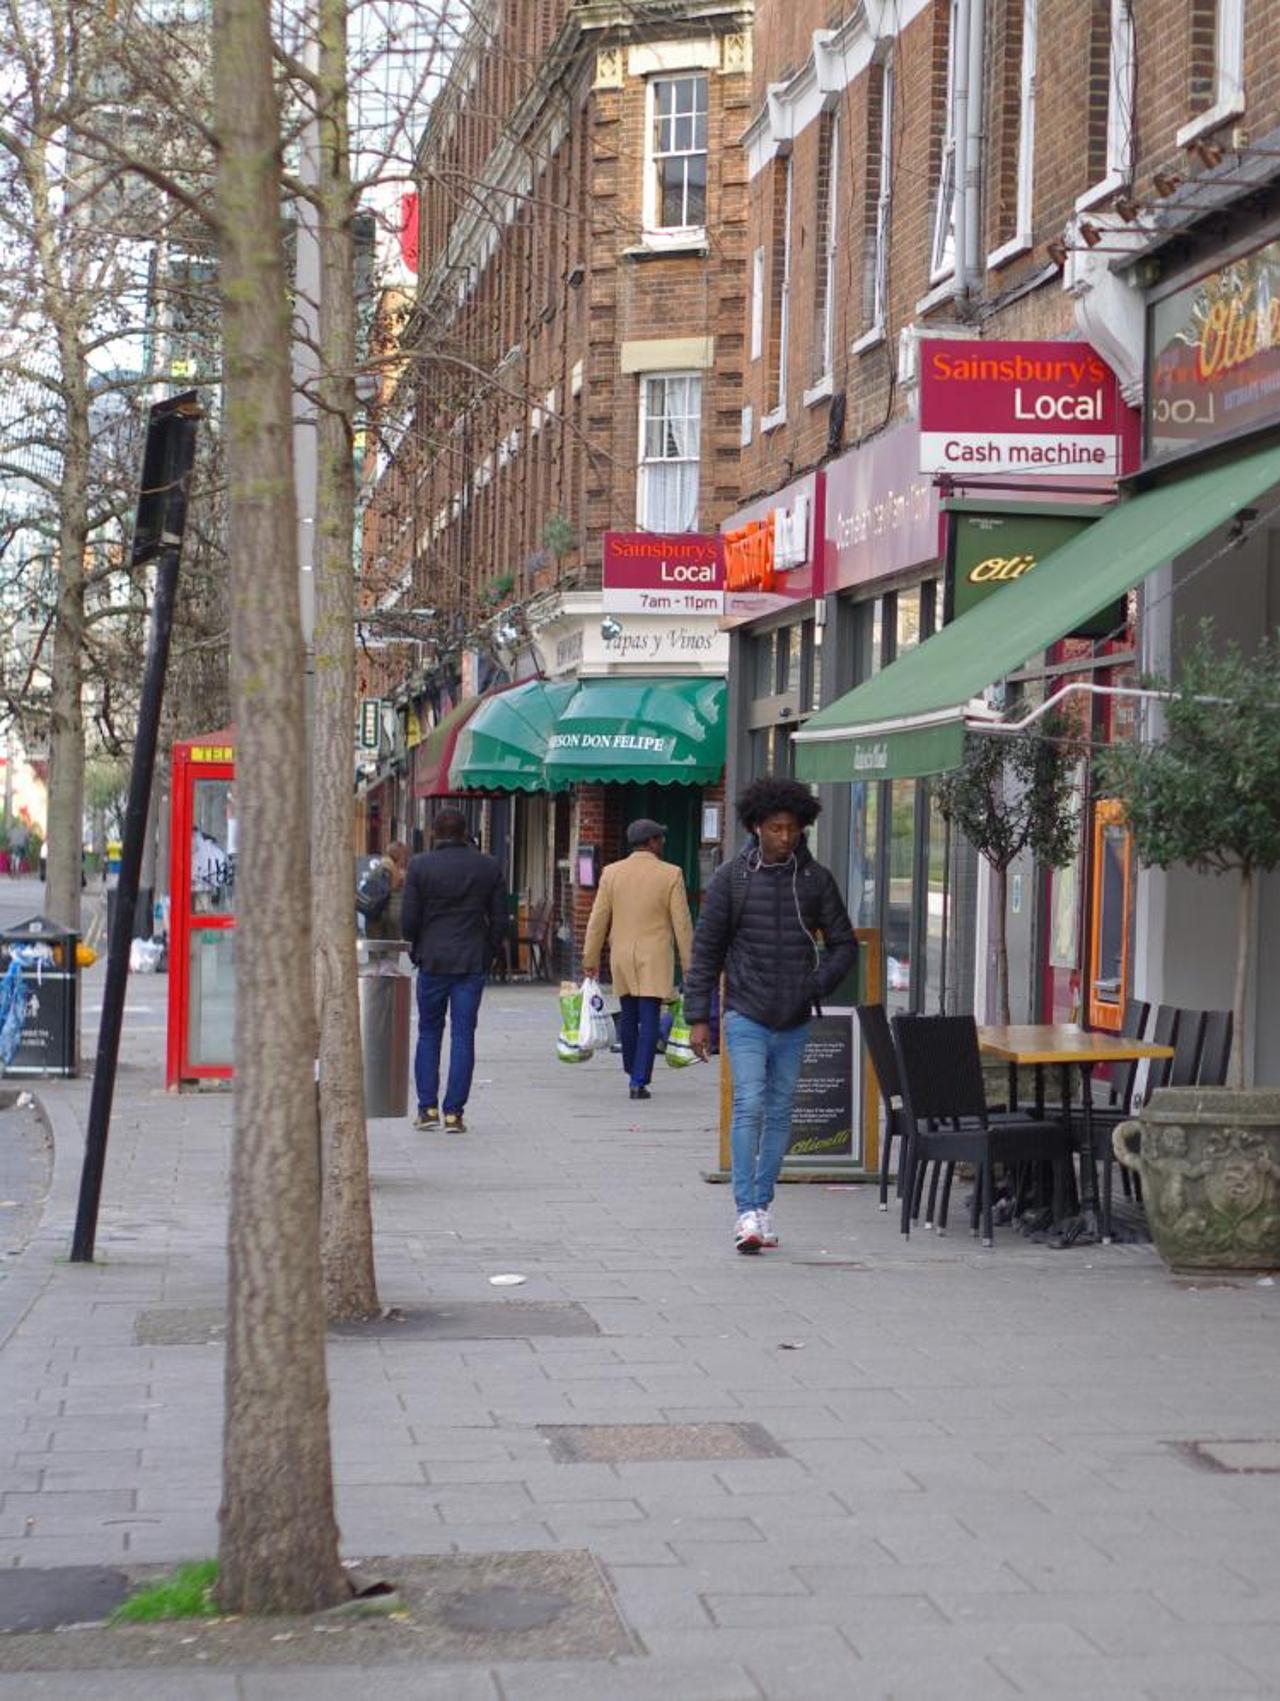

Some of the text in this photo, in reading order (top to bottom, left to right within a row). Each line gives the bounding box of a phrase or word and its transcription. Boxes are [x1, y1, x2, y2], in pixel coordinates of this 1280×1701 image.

[932, 353, 1105, 388] Sainsbury's
[1014, 387, 1103, 420] Local
[944, 440, 1106, 465] Cash machine
[661, 561, 716, 582] Local
[640, 594, 671, 609] 7am
[684, 594, 718, 612] 11pm
[650, 633, 662, 657] y
[582, 734, 610, 748] DON
[613, 734, 664, 752] FELIPE
